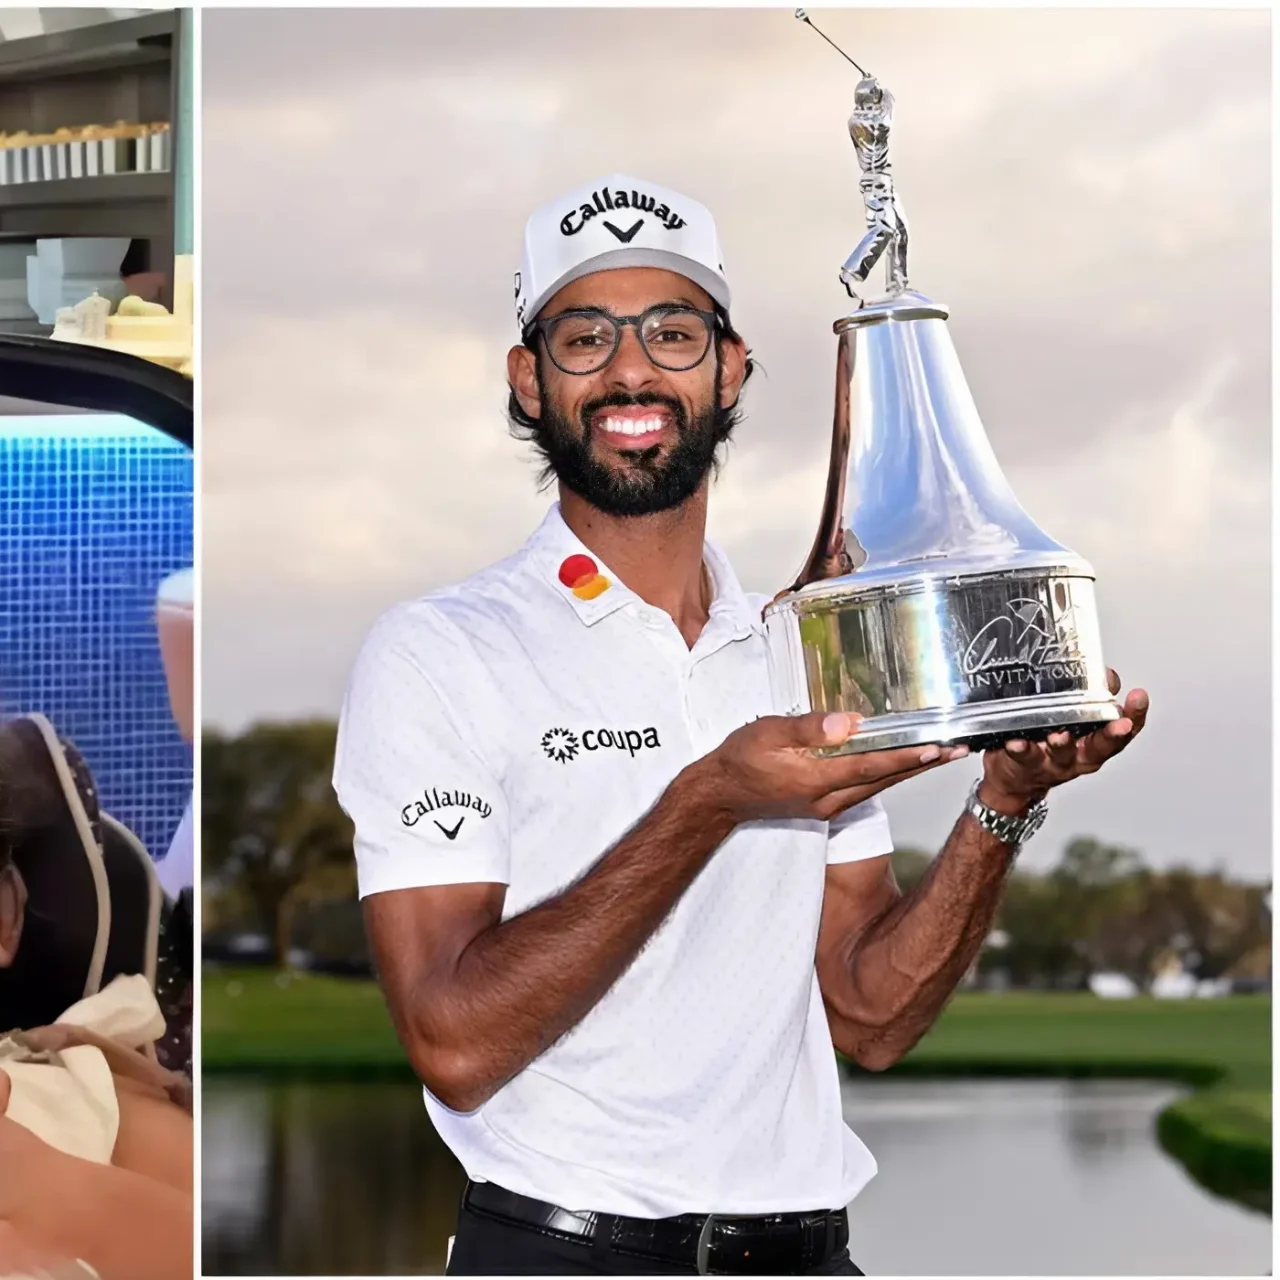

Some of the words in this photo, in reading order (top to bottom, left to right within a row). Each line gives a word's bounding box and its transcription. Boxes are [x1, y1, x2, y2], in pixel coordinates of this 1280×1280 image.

[560, 187, 687, 236] Callaway
[582, 727, 661, 757] coupa
[401, 787, 492, 827] Callaway
